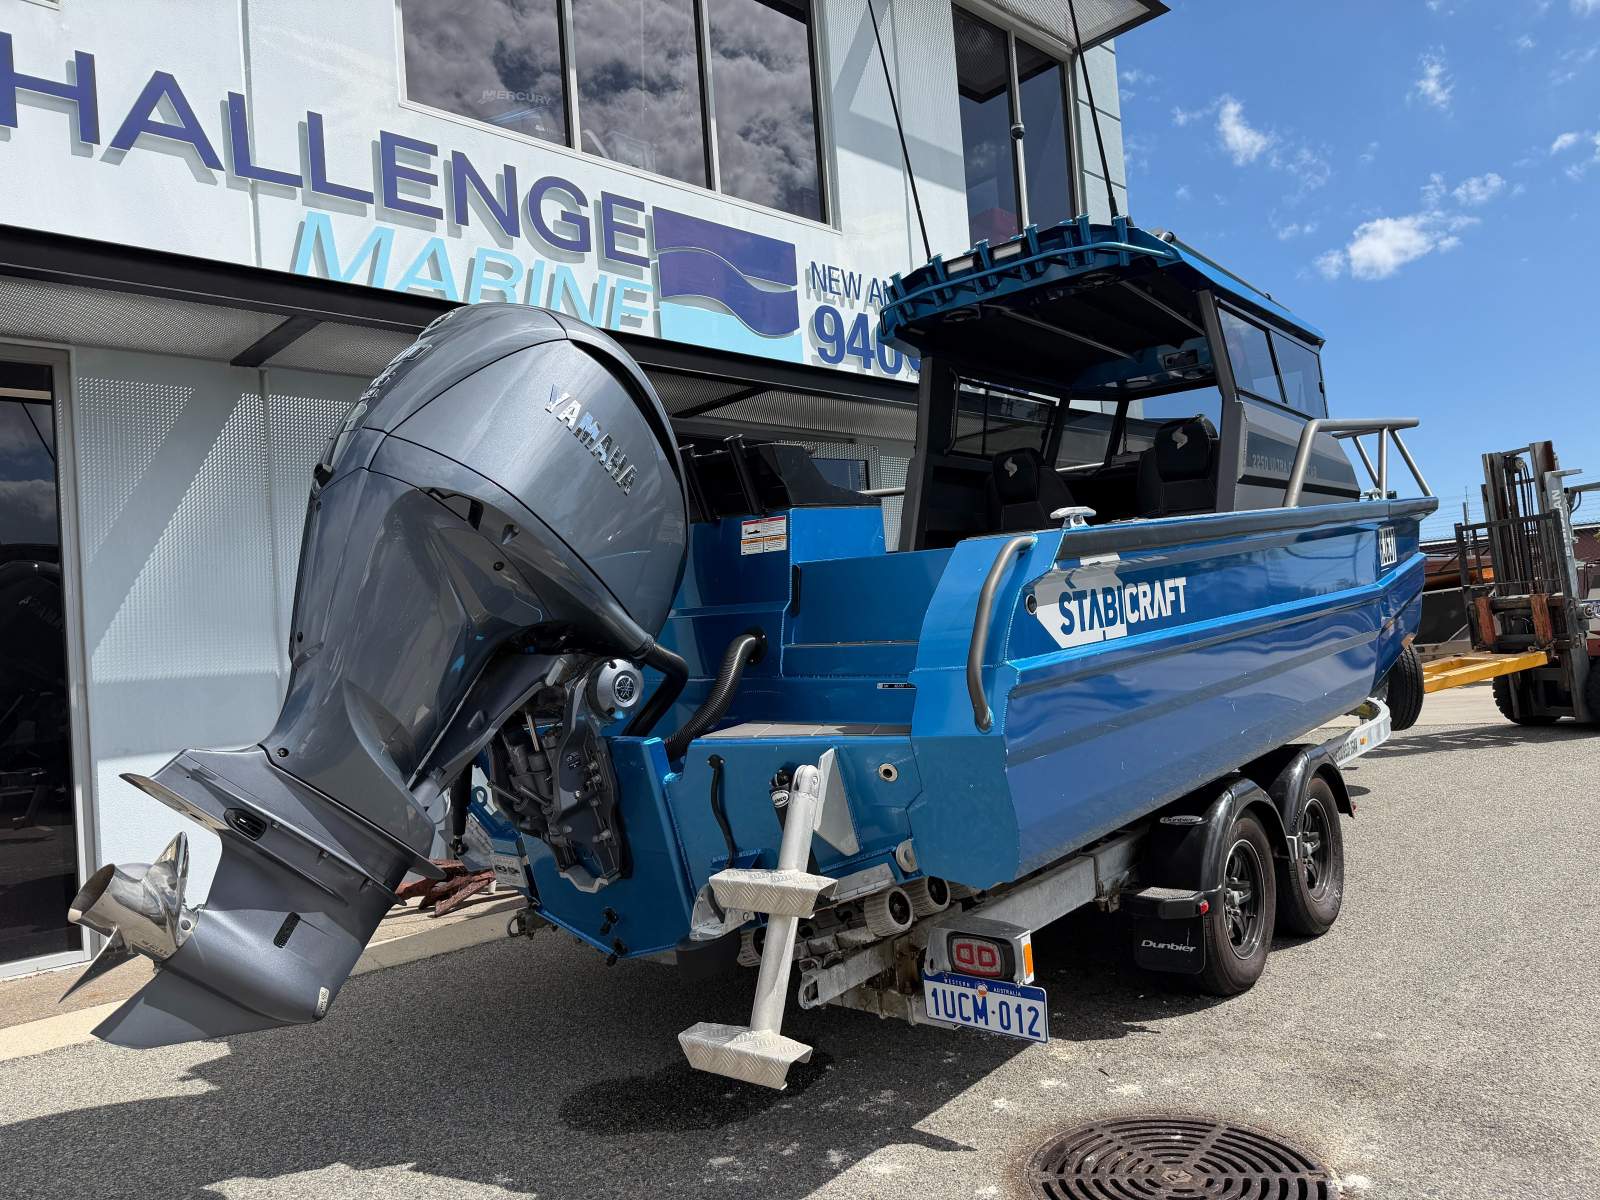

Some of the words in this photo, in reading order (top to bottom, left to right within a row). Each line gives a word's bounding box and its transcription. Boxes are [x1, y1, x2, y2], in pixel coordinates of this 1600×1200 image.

[478, 89, 552, 105] MERCURY
[811, 261, 862, 301] NEW
[815, 304, 921, 375] 940
[545, 384, 639, 496] YAMAHA
[1058, 576, 1187, 636] STABICRAFT
[1141, 939, 1197, 953] Dunbier
[943, 978, 970, 988] WESTERN
[993, 986, 1022, 998] AUSTRALIA
